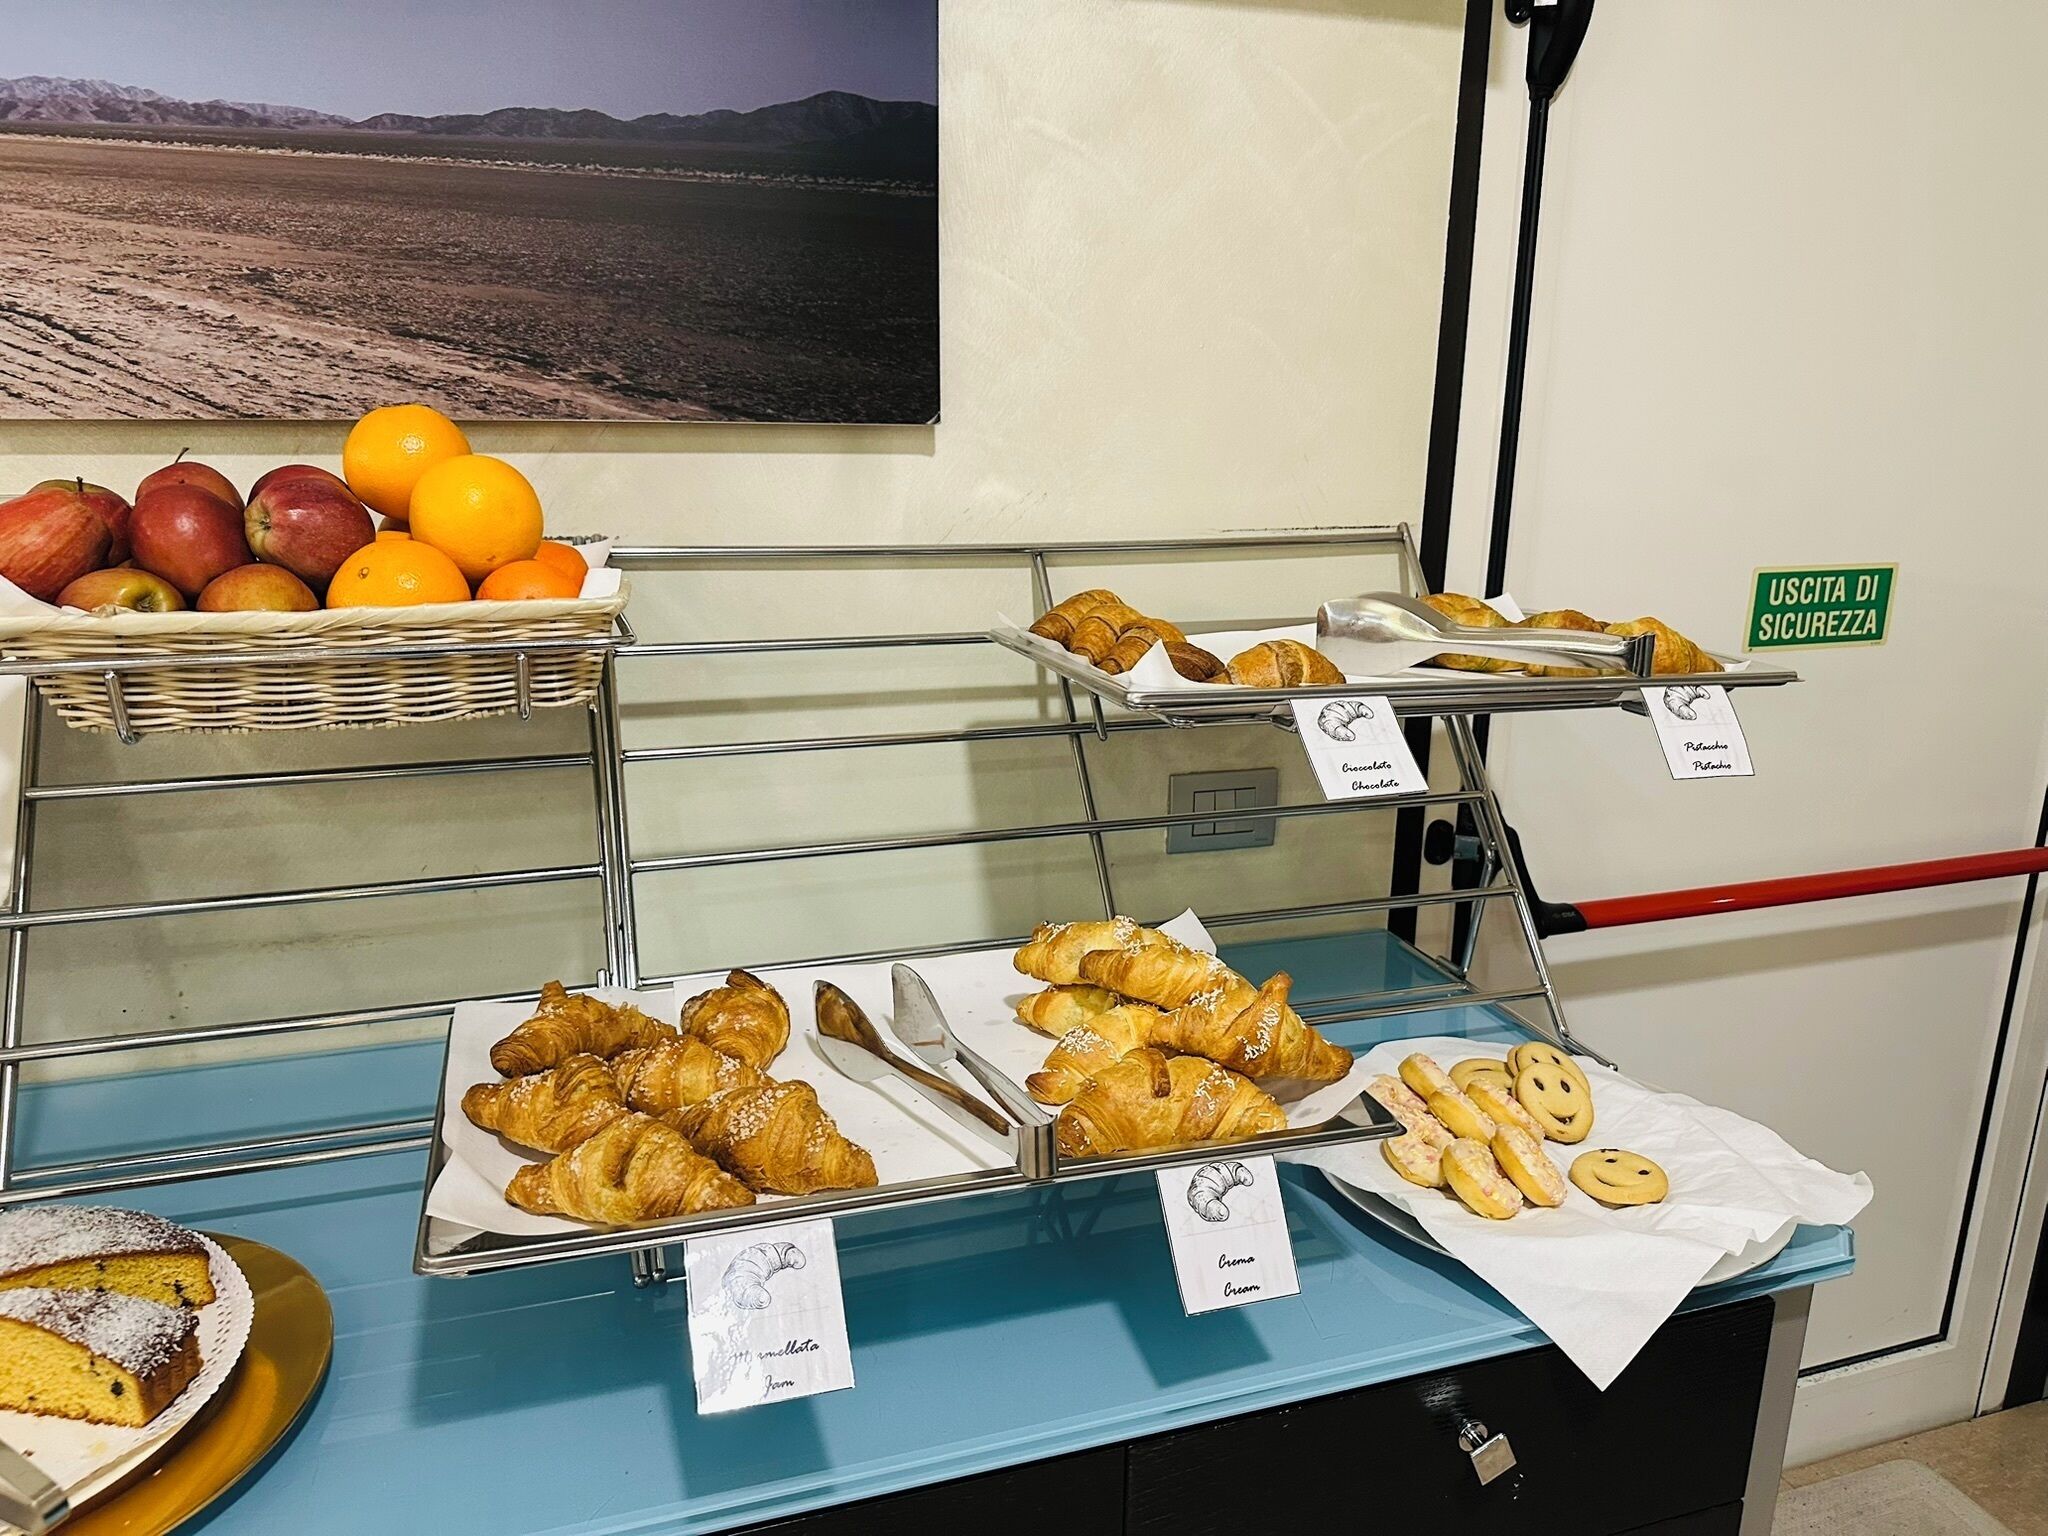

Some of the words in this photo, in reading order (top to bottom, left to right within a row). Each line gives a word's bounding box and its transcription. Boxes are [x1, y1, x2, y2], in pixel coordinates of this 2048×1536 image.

[1769, 576, 1846, 606] USCITA
[1855, 574, 1879, 602] DI
[1758, 609, 1877, 641] SICUREZZA
[1684, 740, 1728, 752] Pistacchio
[1342, 761, 1392, 773] Cioccolato
[1692, 760, 1731, 771] Pistachio
[1352, 779, 1399, 791] Chocolate
[1218, 1253, 1255, 1269] Crema
[1224, 1282, 1260, 1297] Cream
[729, 1339, 820, 1362] Mrmellata
[763, 1374, 795, 1398] Jam
